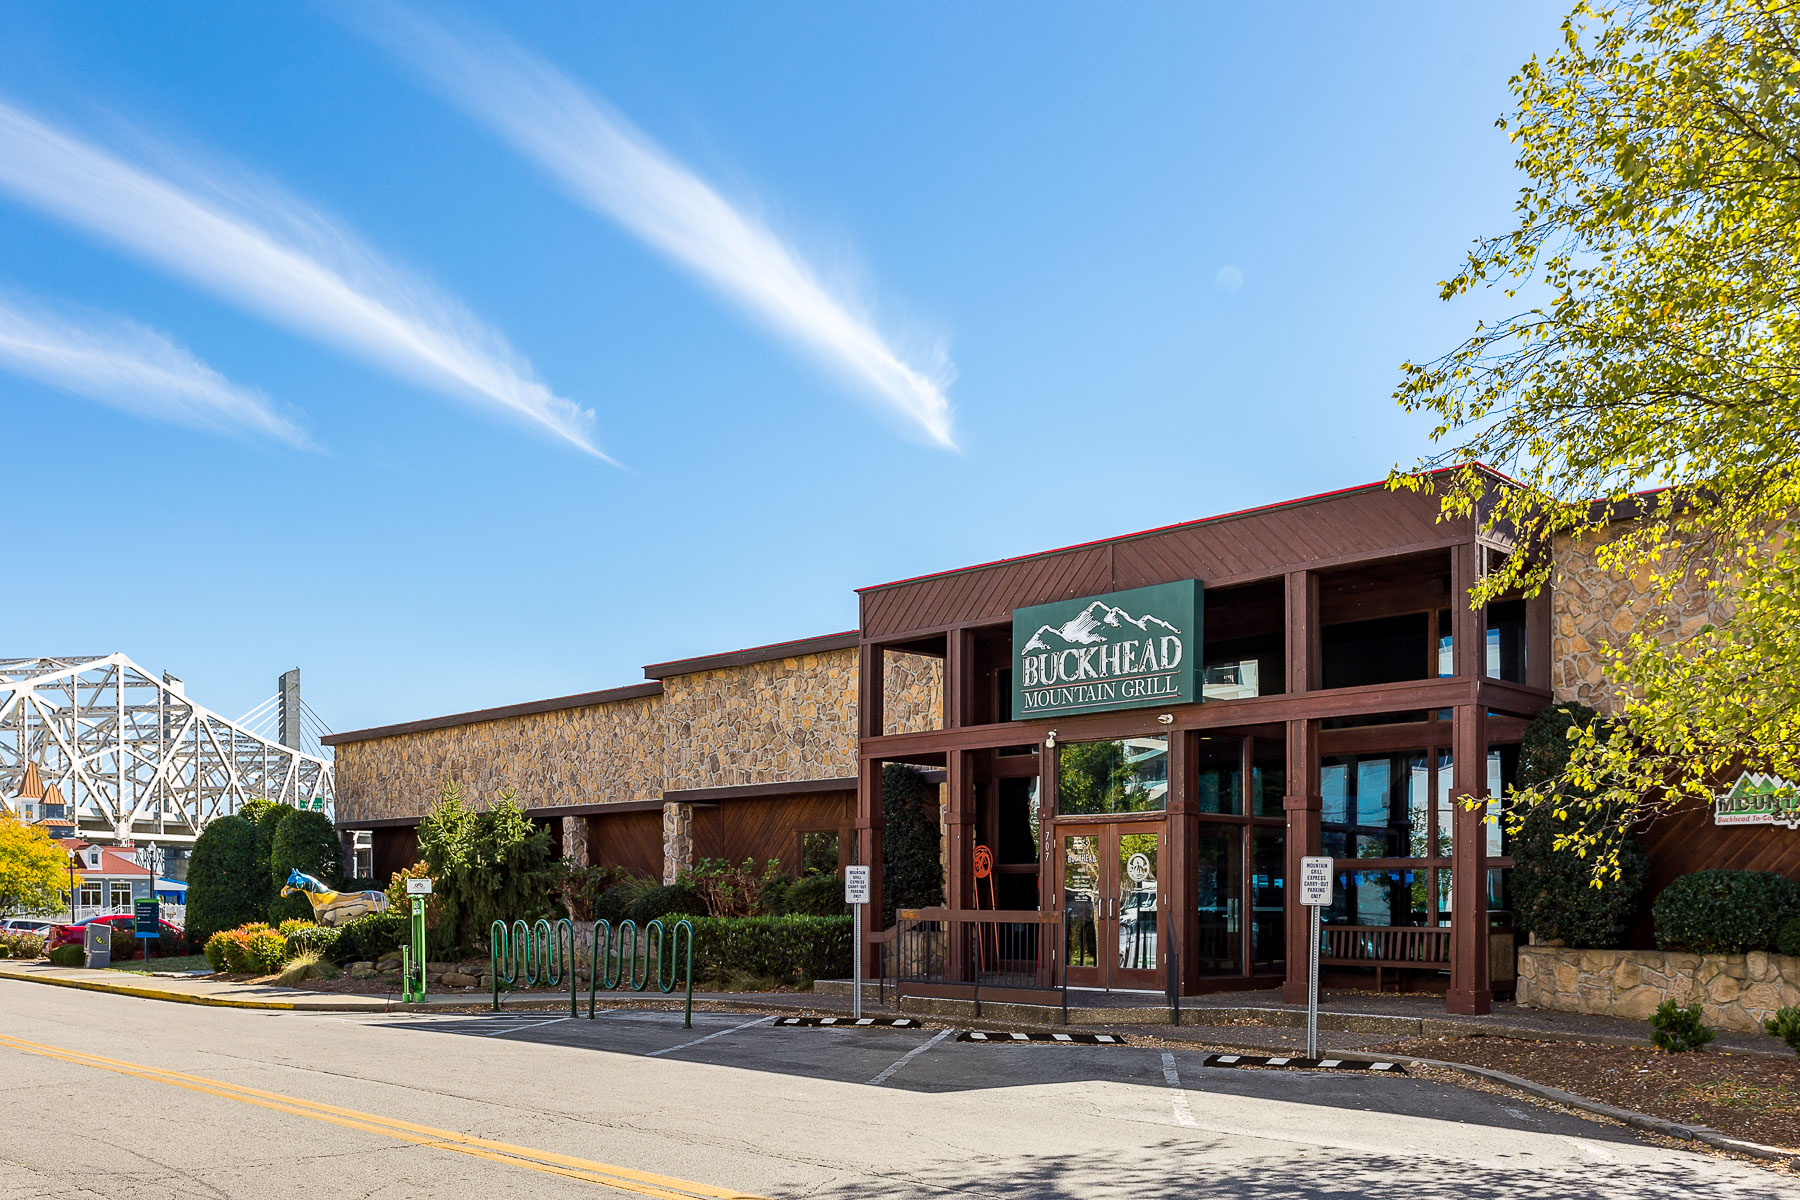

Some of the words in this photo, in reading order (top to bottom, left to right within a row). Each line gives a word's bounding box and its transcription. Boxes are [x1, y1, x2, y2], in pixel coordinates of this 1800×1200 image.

[1022, 635, 1182, 687] BUCKHEAD
[1024, 682, 1116, 709] MOUNTAIN
[1121, 675, 1178, 698] GRILL
[1717, 793, 1800, 812] MOUNT
[1717, 815, 1750, 823] Buckhead
